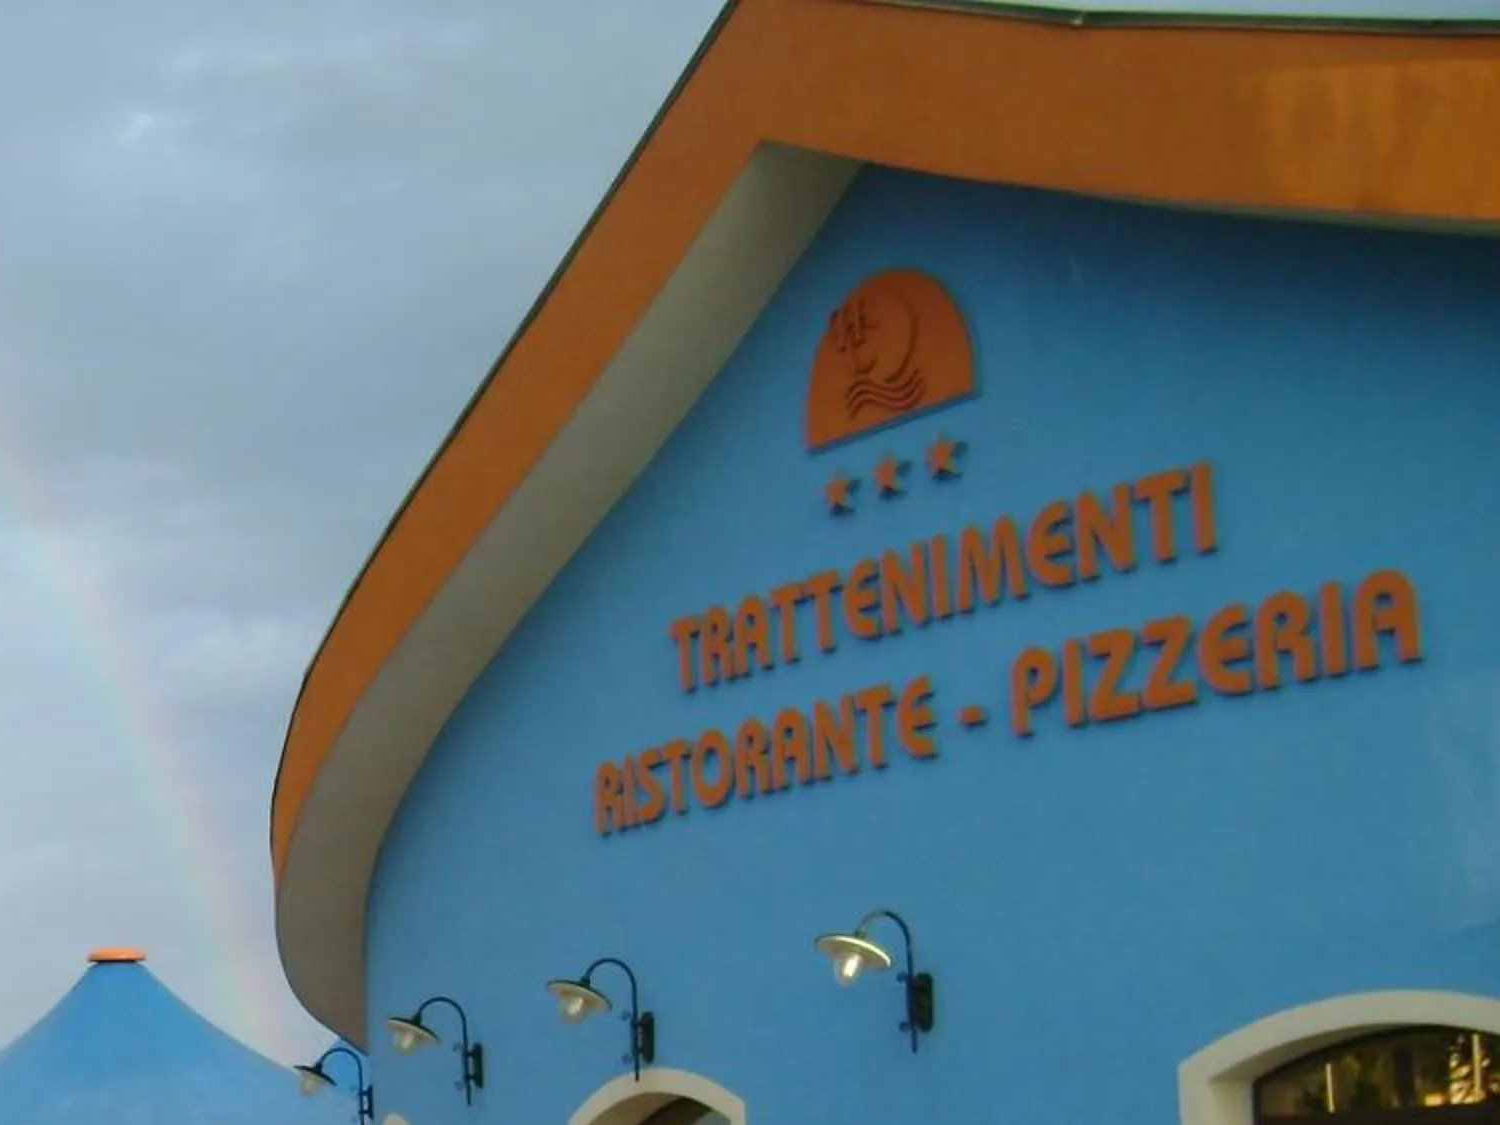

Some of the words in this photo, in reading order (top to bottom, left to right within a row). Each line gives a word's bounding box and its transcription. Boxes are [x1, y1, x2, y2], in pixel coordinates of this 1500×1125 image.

[669, 460, 1217, 692] TRATTENIMENTI
[593, 675, 937, 834] RISTORANTE
[1010, 569, 1422, 736] PIZZERIA
